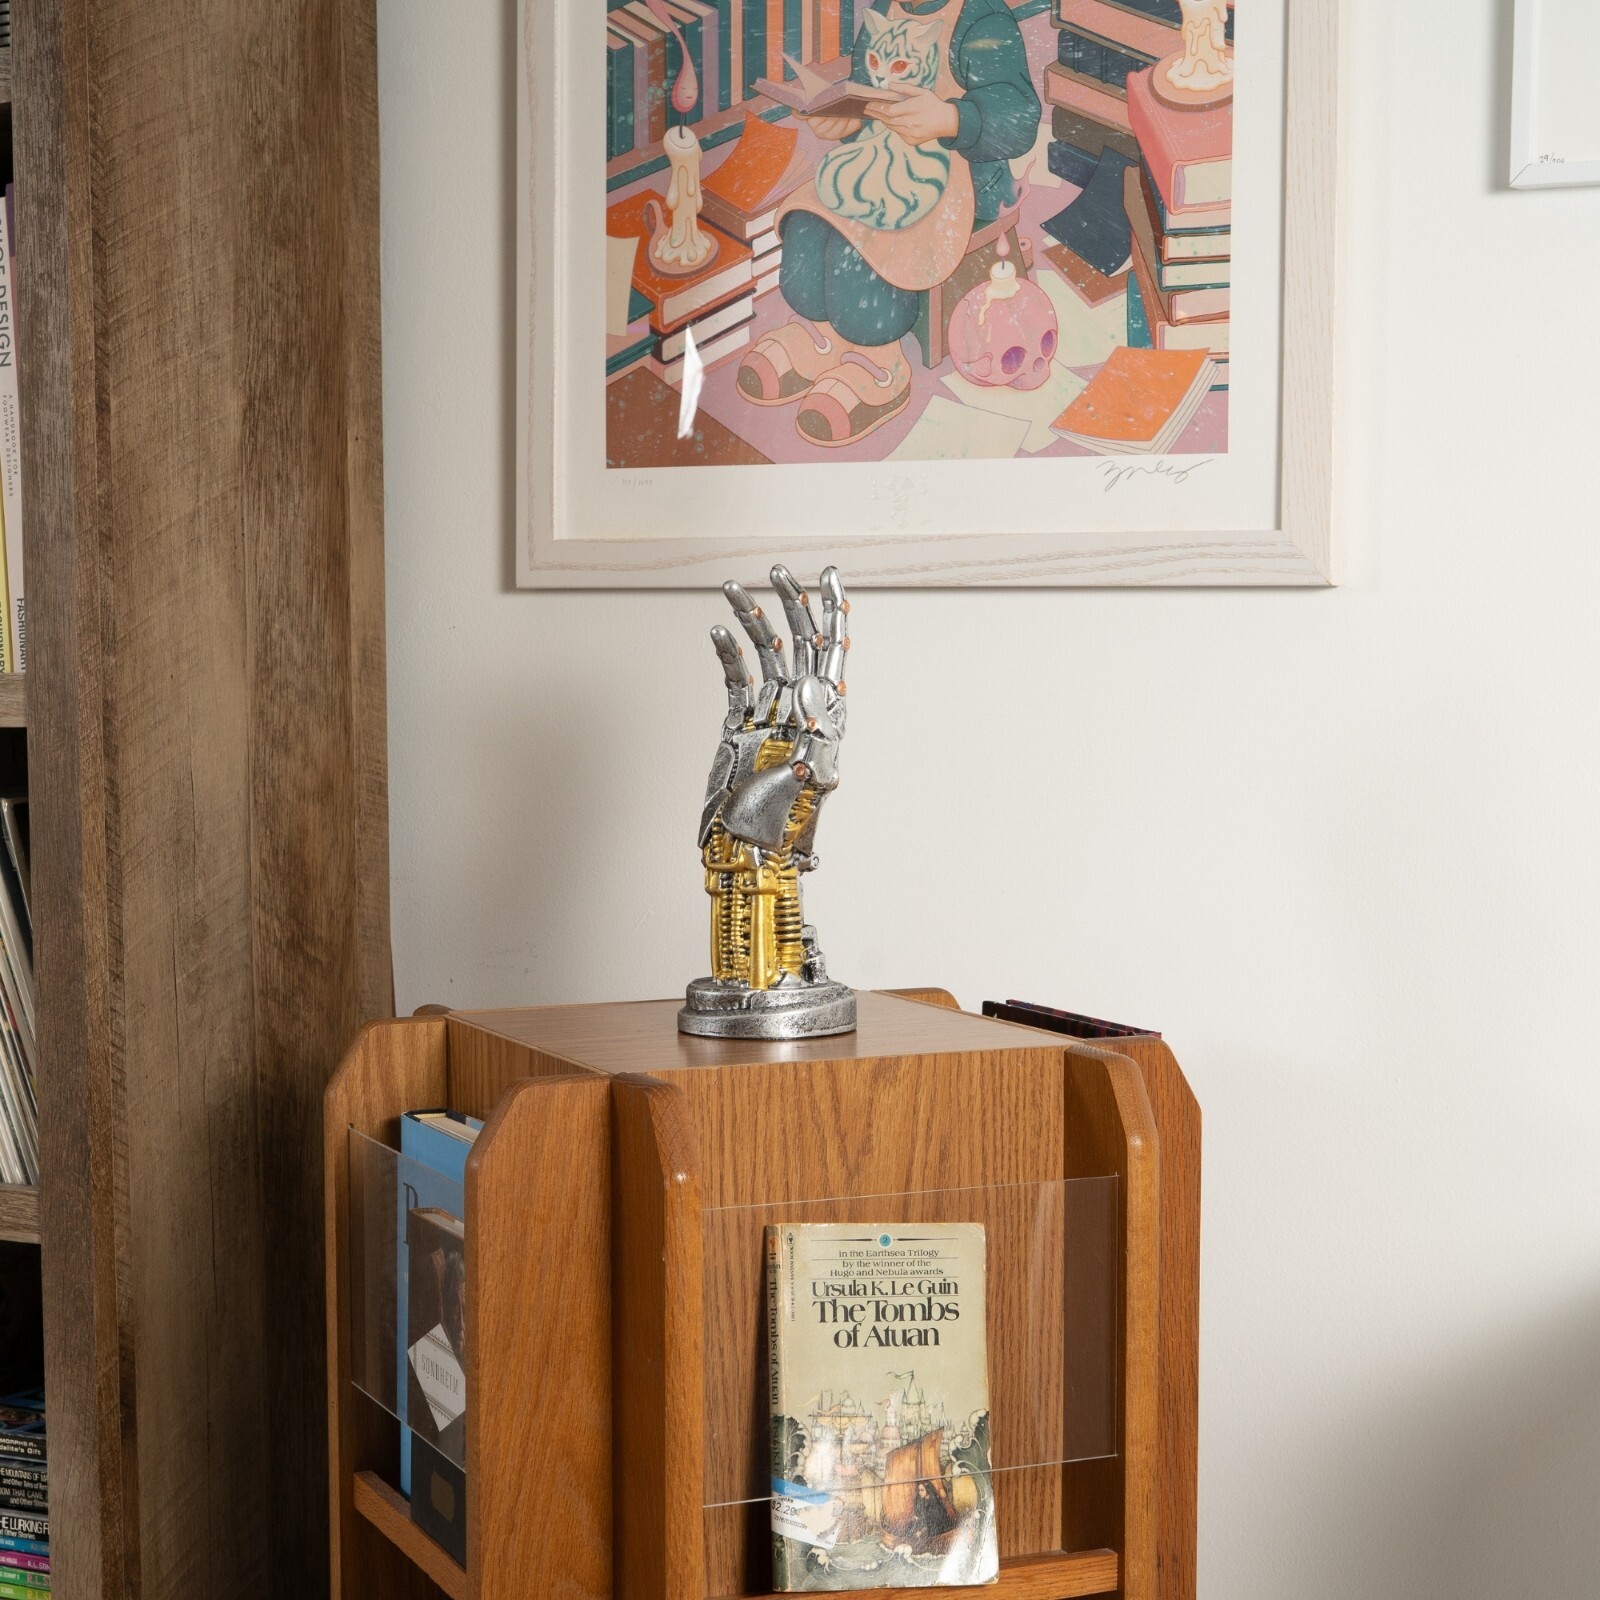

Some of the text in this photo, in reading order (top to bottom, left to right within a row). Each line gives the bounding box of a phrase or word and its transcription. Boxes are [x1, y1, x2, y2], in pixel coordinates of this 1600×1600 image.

[9, 404, 17, 454] HANDBOOK
[2, 394, 14, 497] FOOTWEAR DESIGNERS
[838, 1249, 940, 1259] in the Earthsea Trilogy
[842, 1259, 932, 1269] by the winner of the
[830, 1267, 944, 1277] Hugo and Nebula awards
[769, 1278, 778, 1302] The
[812, 1278, 959, 1297] Ursula K. Le Guin
[812, 1298, 866, 1324] The
[866, 1296, 960, 1322] Tombs
[770, 1304, 779, 1350] Tombs
[833, 1322, 940, 1348] of Atuan
[770, 1352, 780, 1366] of
[421, 1353, 459, 1395] SONDHEIM
[771, 1366, 780, 1405] Atuan
[10, 1517, 42, 1534] LURKING
